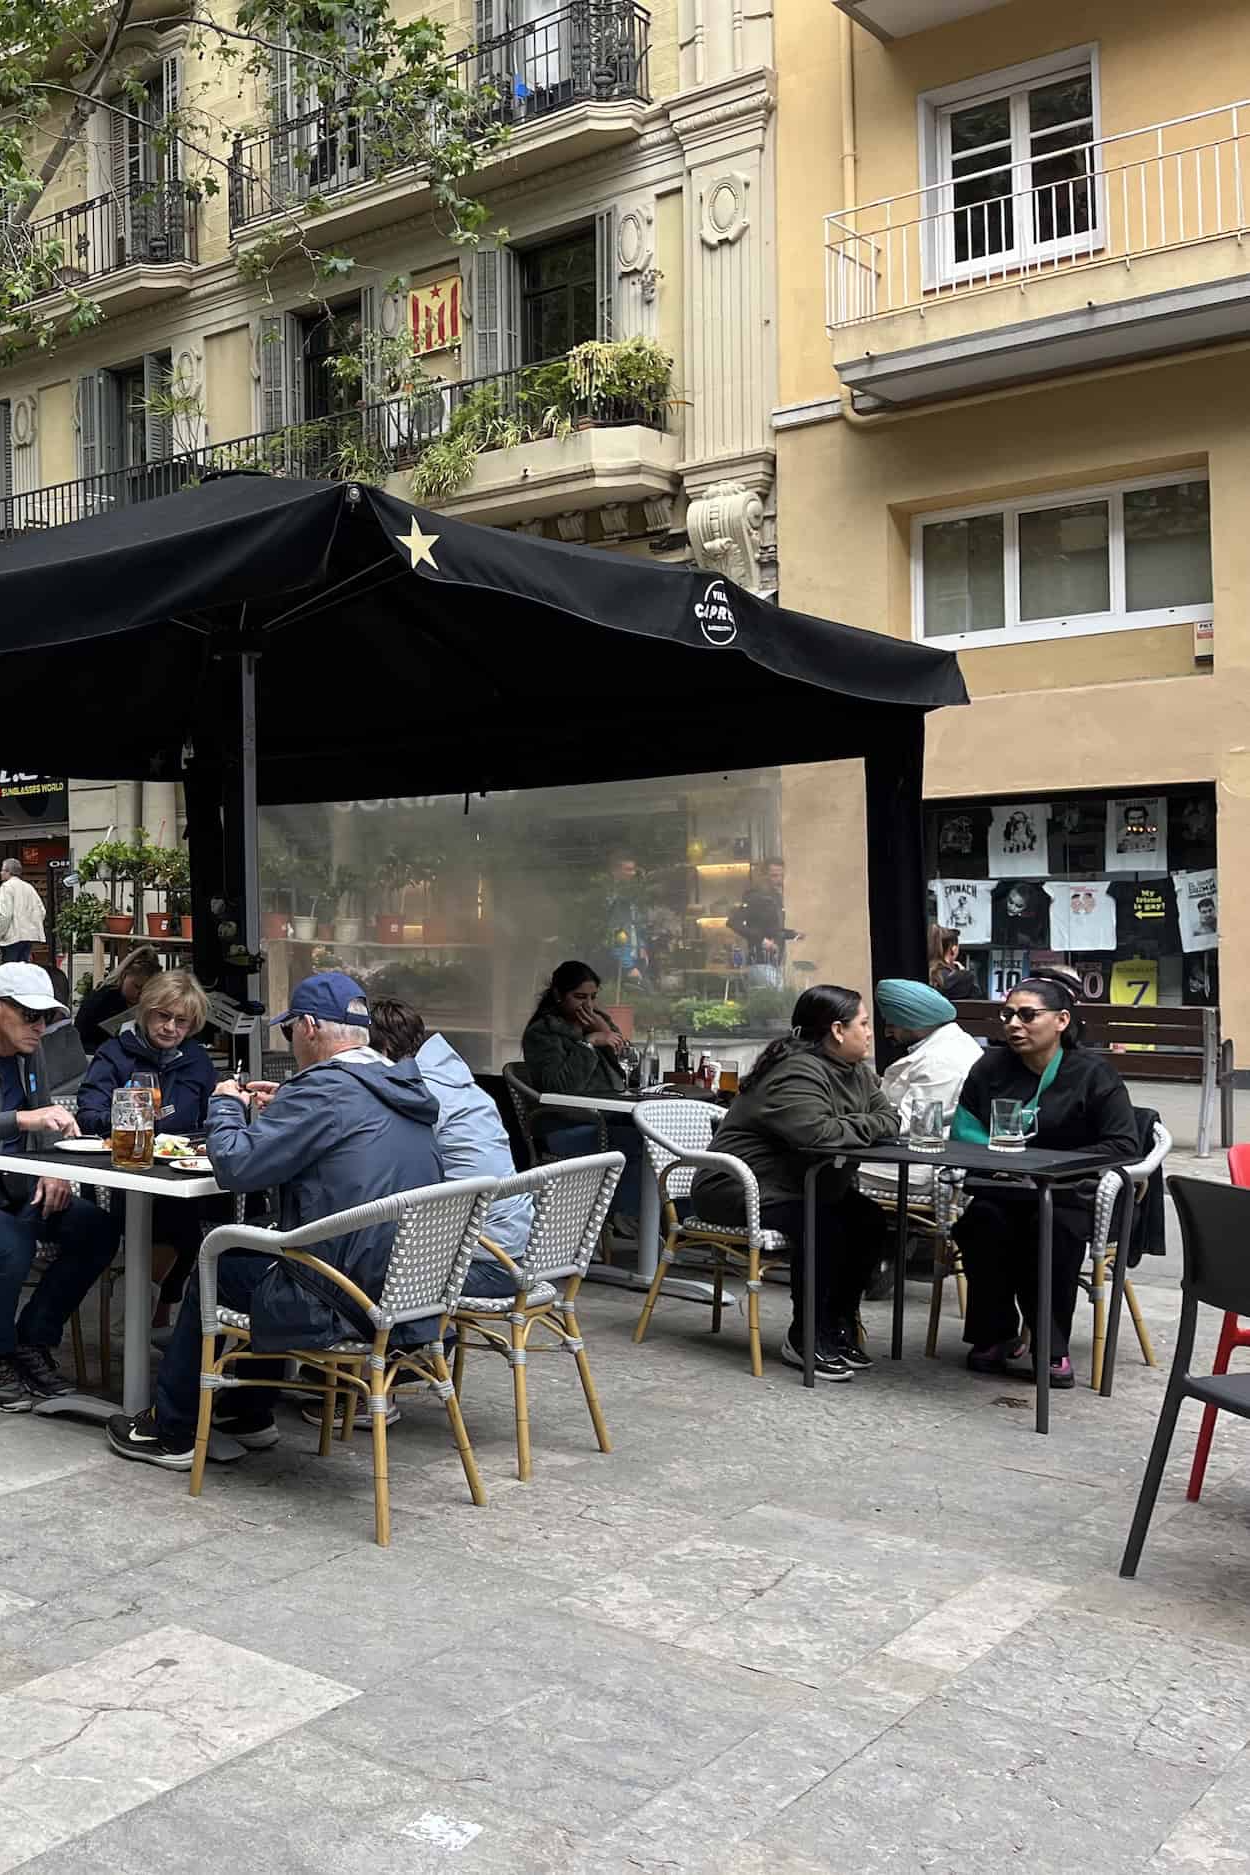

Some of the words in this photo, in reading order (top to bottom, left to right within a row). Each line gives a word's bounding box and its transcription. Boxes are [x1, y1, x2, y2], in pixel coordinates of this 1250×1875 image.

[41, 782, 64, 793] WORLD
[993, 970, 1021, 993] 10
[1127, 980, 1151, 1006] 7
